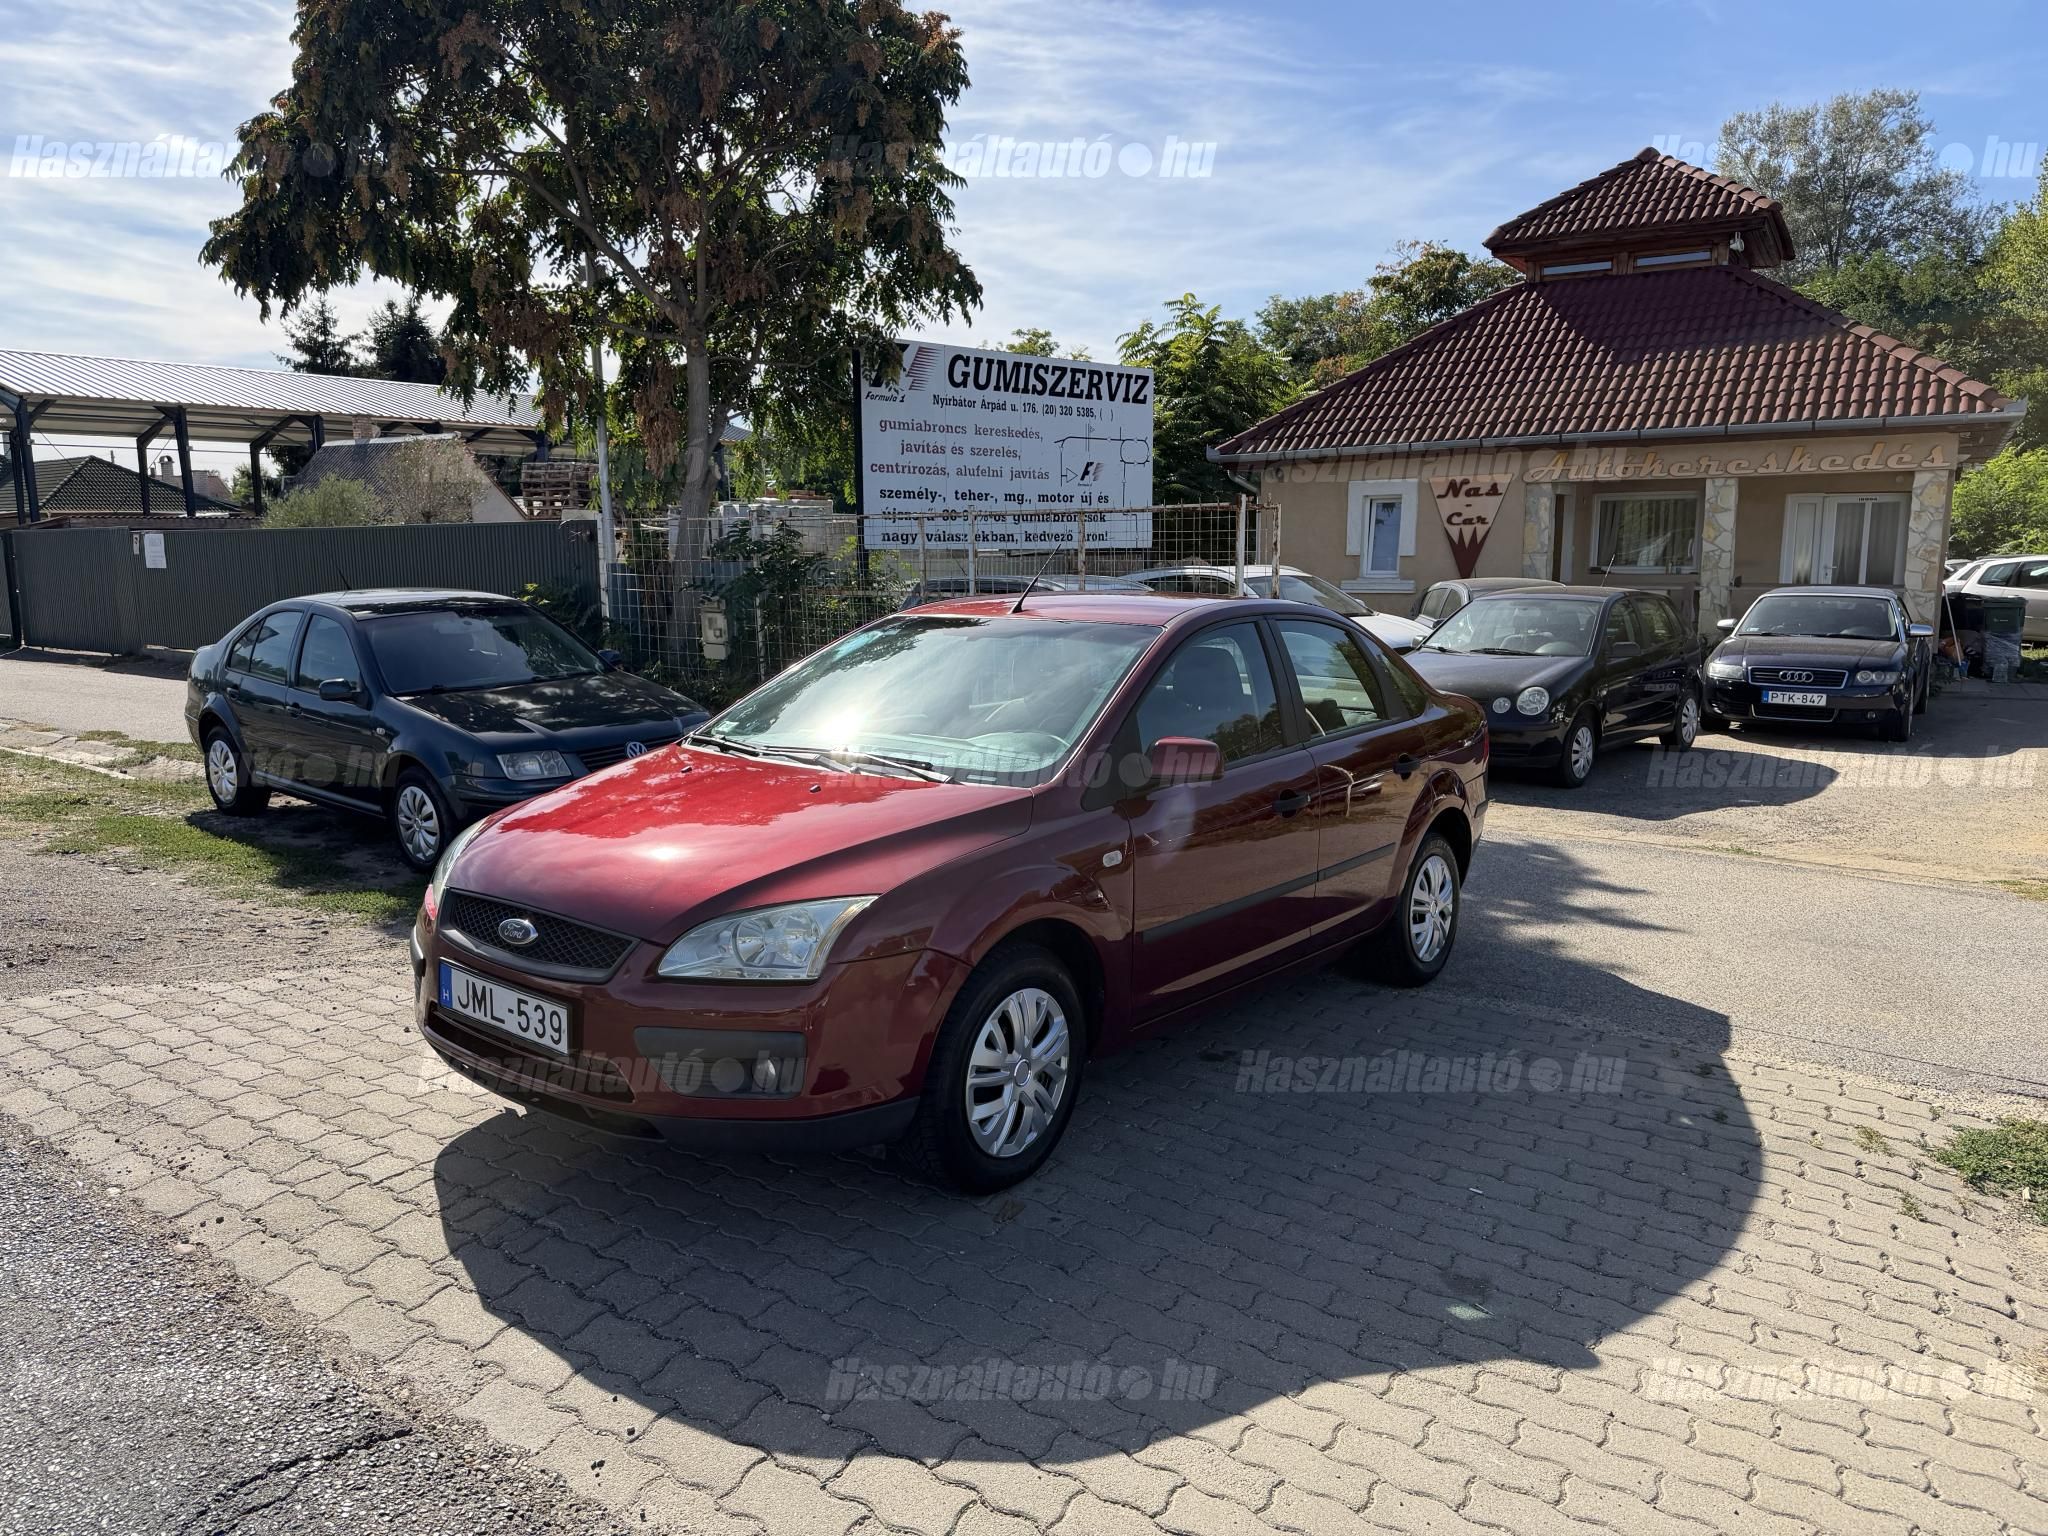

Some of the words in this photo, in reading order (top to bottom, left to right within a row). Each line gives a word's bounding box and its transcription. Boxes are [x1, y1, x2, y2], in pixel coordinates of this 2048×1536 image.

[947, 353, 1150, 405] GUMISZERVIZ
[865, 391, 897, 402] Formula
[1010, 403, 1019, 412] u.
[1022, 402, 1039, 414] 176.
[1042, 404, 1057, 417] (20)
[1059, 405, 1073, 416] 320
[879, 418, 967, 435] gumiabroncs
[974, 423, 1043, 442] kereskedés,
[900, 439, 946, 456] javítás
[951, 442, 964, 455] és
[970, 445, 1022, 461] szerelés,
[1523, 441, 1952, 484] Autókereskedés
[956, 464, 1003, 478] alufelni
[1009, 467, 1050, 481] javítás
[879, 486, 946, 503] személy-,
[954, 489, 998, 504] teher-,
[1038, 492, 1075, 503] motor
[1081, 491, 1092, 506] új
[1097, 491, 1109, 503] és
[1436, 478, 1503, 499] Nas
[1446, 511, 1488, 526] Car
[881, 531, 918, 545] nagy
[926, 528, 1019, 545] válaszékban,
[1024, 529, 1074, 542] kedvező
[1080, 531, 1108, 542] ron!
[1770, 692, 1824, 705] PTK-847
[504, 923, 525, 939] Ford
[457, 978, 563, 1046] JML-539
